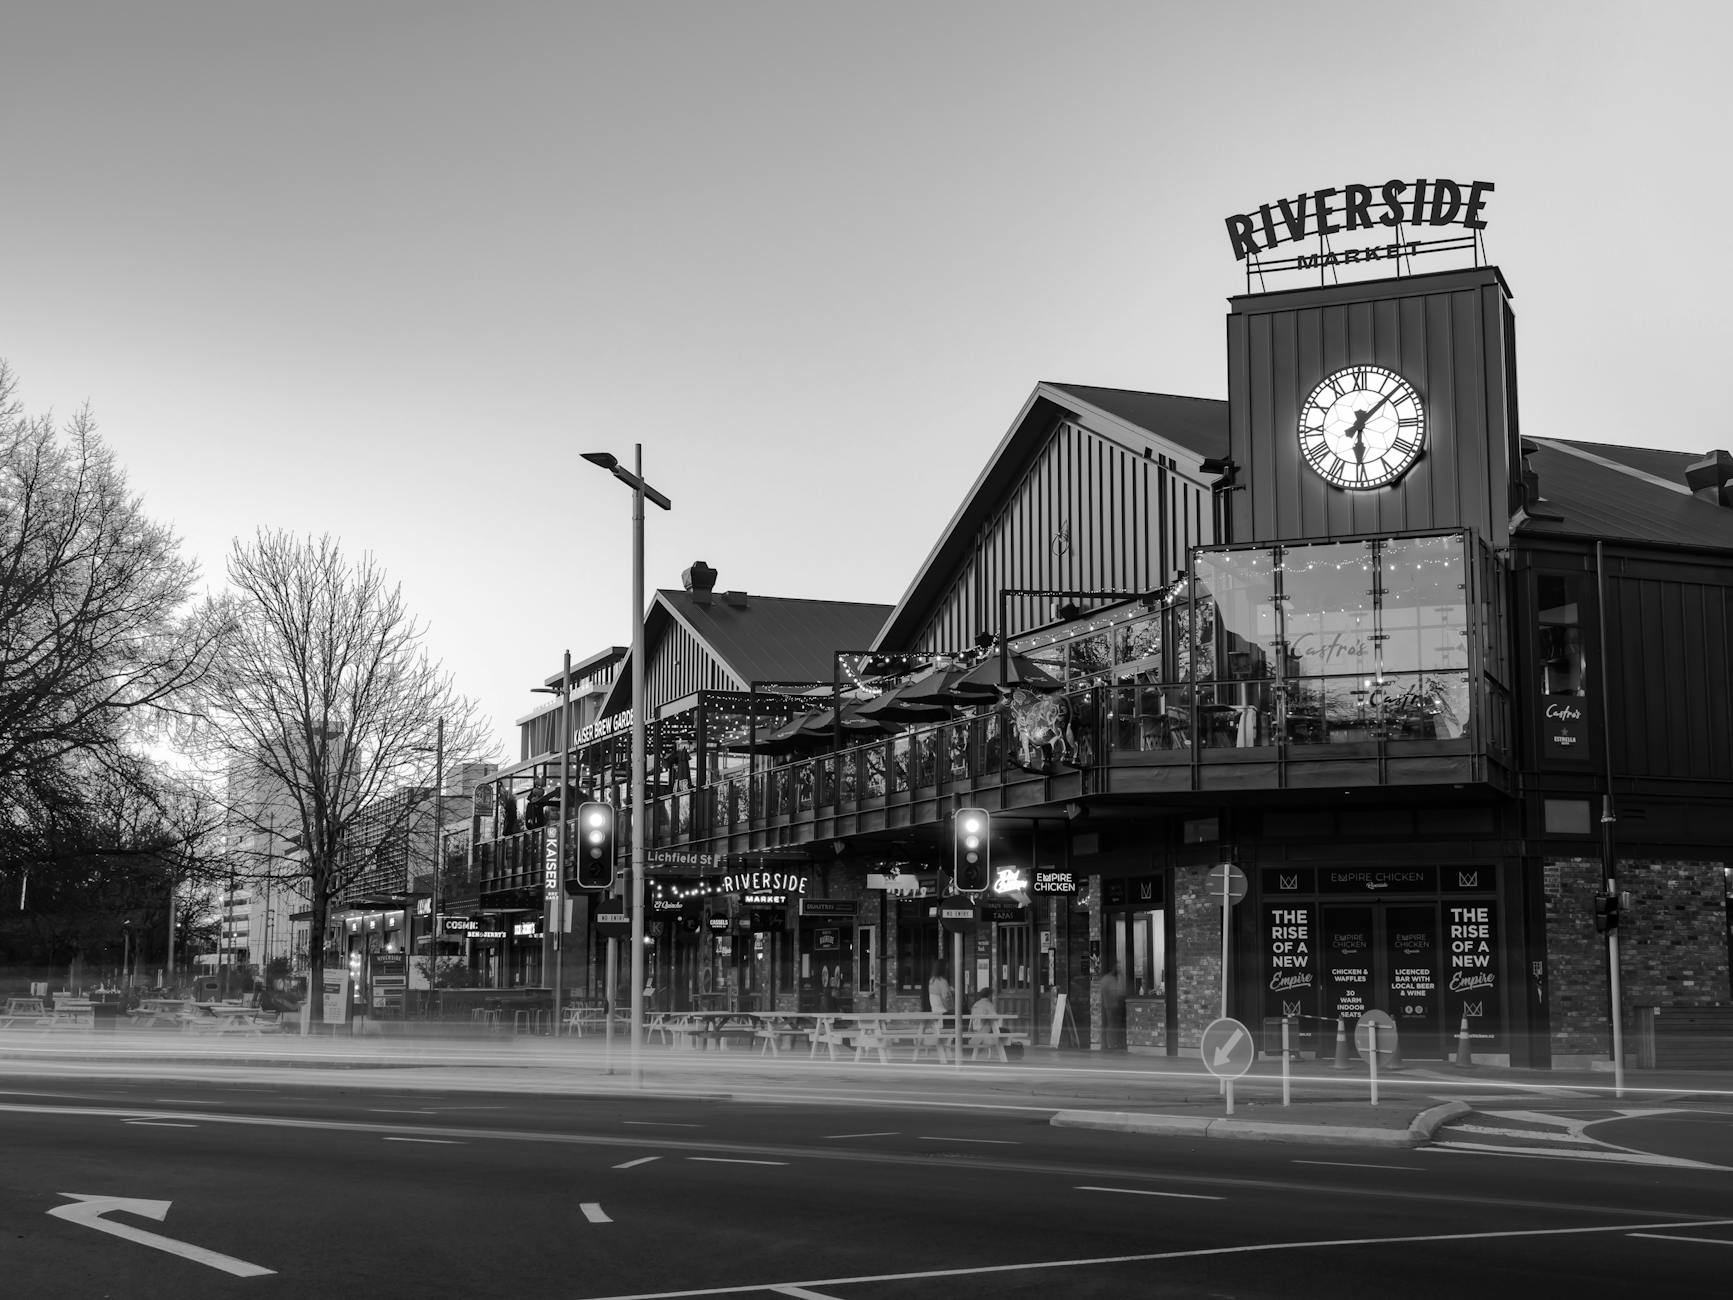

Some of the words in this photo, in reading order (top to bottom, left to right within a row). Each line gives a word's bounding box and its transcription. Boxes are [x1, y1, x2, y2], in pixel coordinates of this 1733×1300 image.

[1225, 178, 1495, 262] RIVERSIDE
[1297, 240, 1421, 270] MARKET
[1290, 632, 1369, 663] Castro's
[1546, 704, 1581, 720] Castro's
[573, 723, 594, 747] KAISER
[594, 715, 613, 739] BREW
[613, 708, 633, 731] GARDE
[545, 839, 558, 888] KAISER
[647, 851, 698, 864] Lichfield
[700, 853, 713, 866] St
[724, 872, 808, 894] RIVERSIDE
[1036, 873, 1073, 883] EMPIRE
[1331, 872, 1373, 882] EMPIRE
[1375, 872, 1424, 882] CHICKEN
[1033, 882, 1076, 892] CHICKEN
[745, 895, 787, 903] MARKET
[1271, 909, 1308, 924] THE
[1450, 908, 1489, 923] THE
[1271, 926, 1309, 940] RISE
[1450, 925, 1490, 938] RISE
[1272, 942, 1293, 954] OF
[1297, 942, 1309, 954] A
[1451, 941, 1474, 953] OF
[1477, 941, 1490, 953] A
[1272, 956, 1309, 968] NEW
[1451, 955, 1490, 968] NEW
[1269, 970, 1313, 990] Empire
[1449, 970, 1496, 990] Empire
